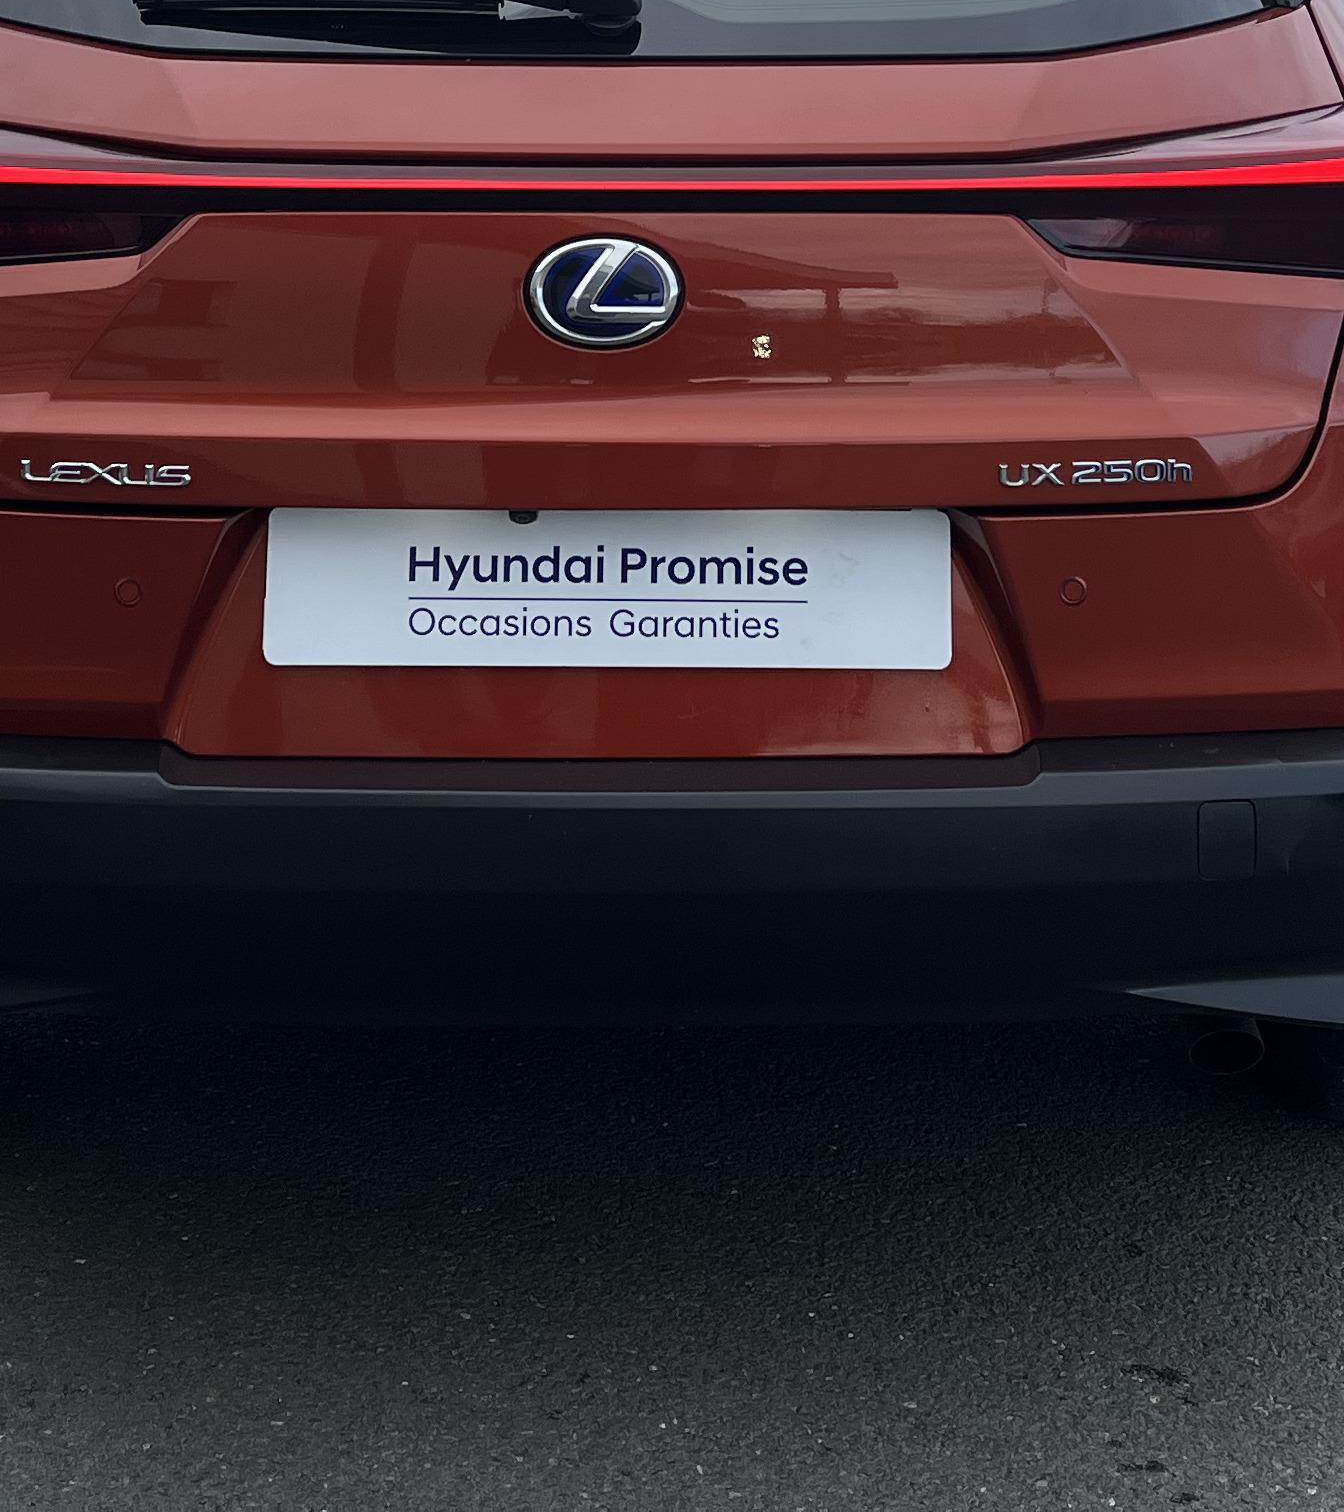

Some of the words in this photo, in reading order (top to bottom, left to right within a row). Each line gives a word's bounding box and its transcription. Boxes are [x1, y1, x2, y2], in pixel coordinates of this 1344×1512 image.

[20, 459, 192, 486] LEXUS
[998, 462, 1065, 487] UX
[1071, 458, 1193, 485] 250h
[408, 544, 605, 591] Hyundai
[620, 546, 809, 586] Promise
[408, 606, 592, 637] Occasions
[609, 608, 780, 639] Garanties
